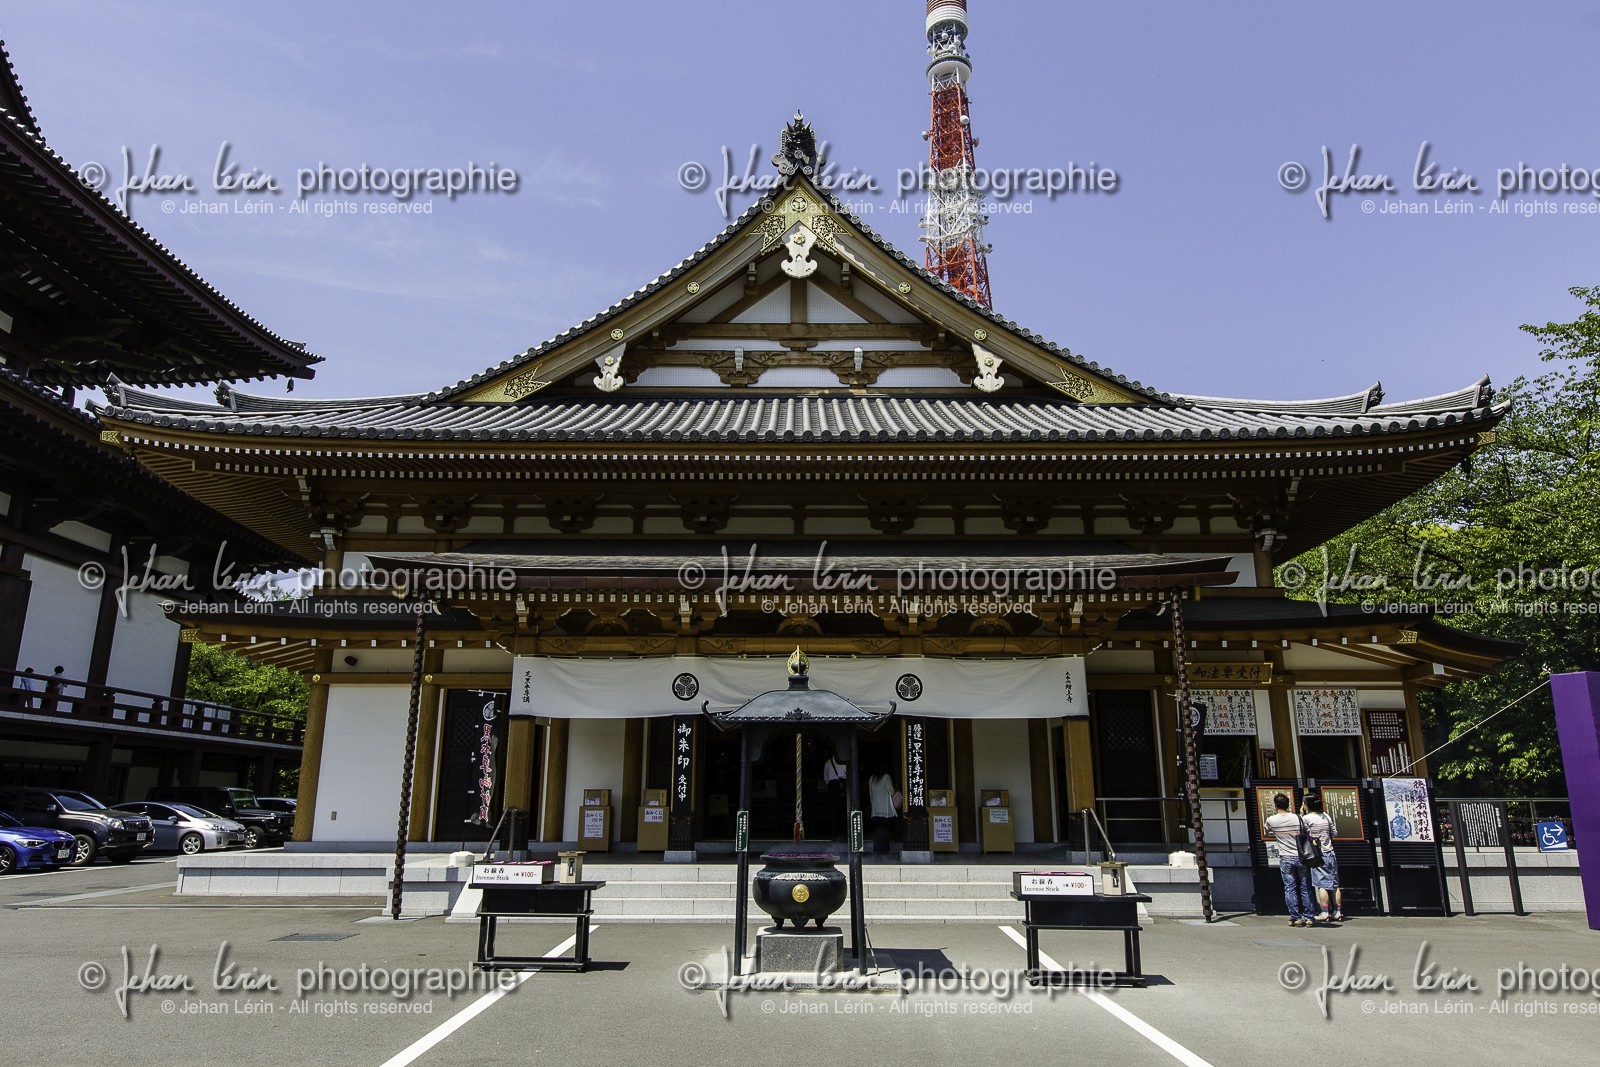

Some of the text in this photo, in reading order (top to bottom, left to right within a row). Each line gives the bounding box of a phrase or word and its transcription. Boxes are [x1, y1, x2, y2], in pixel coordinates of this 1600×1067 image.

[677, 723, 692, 802] 御朱印 受付中
